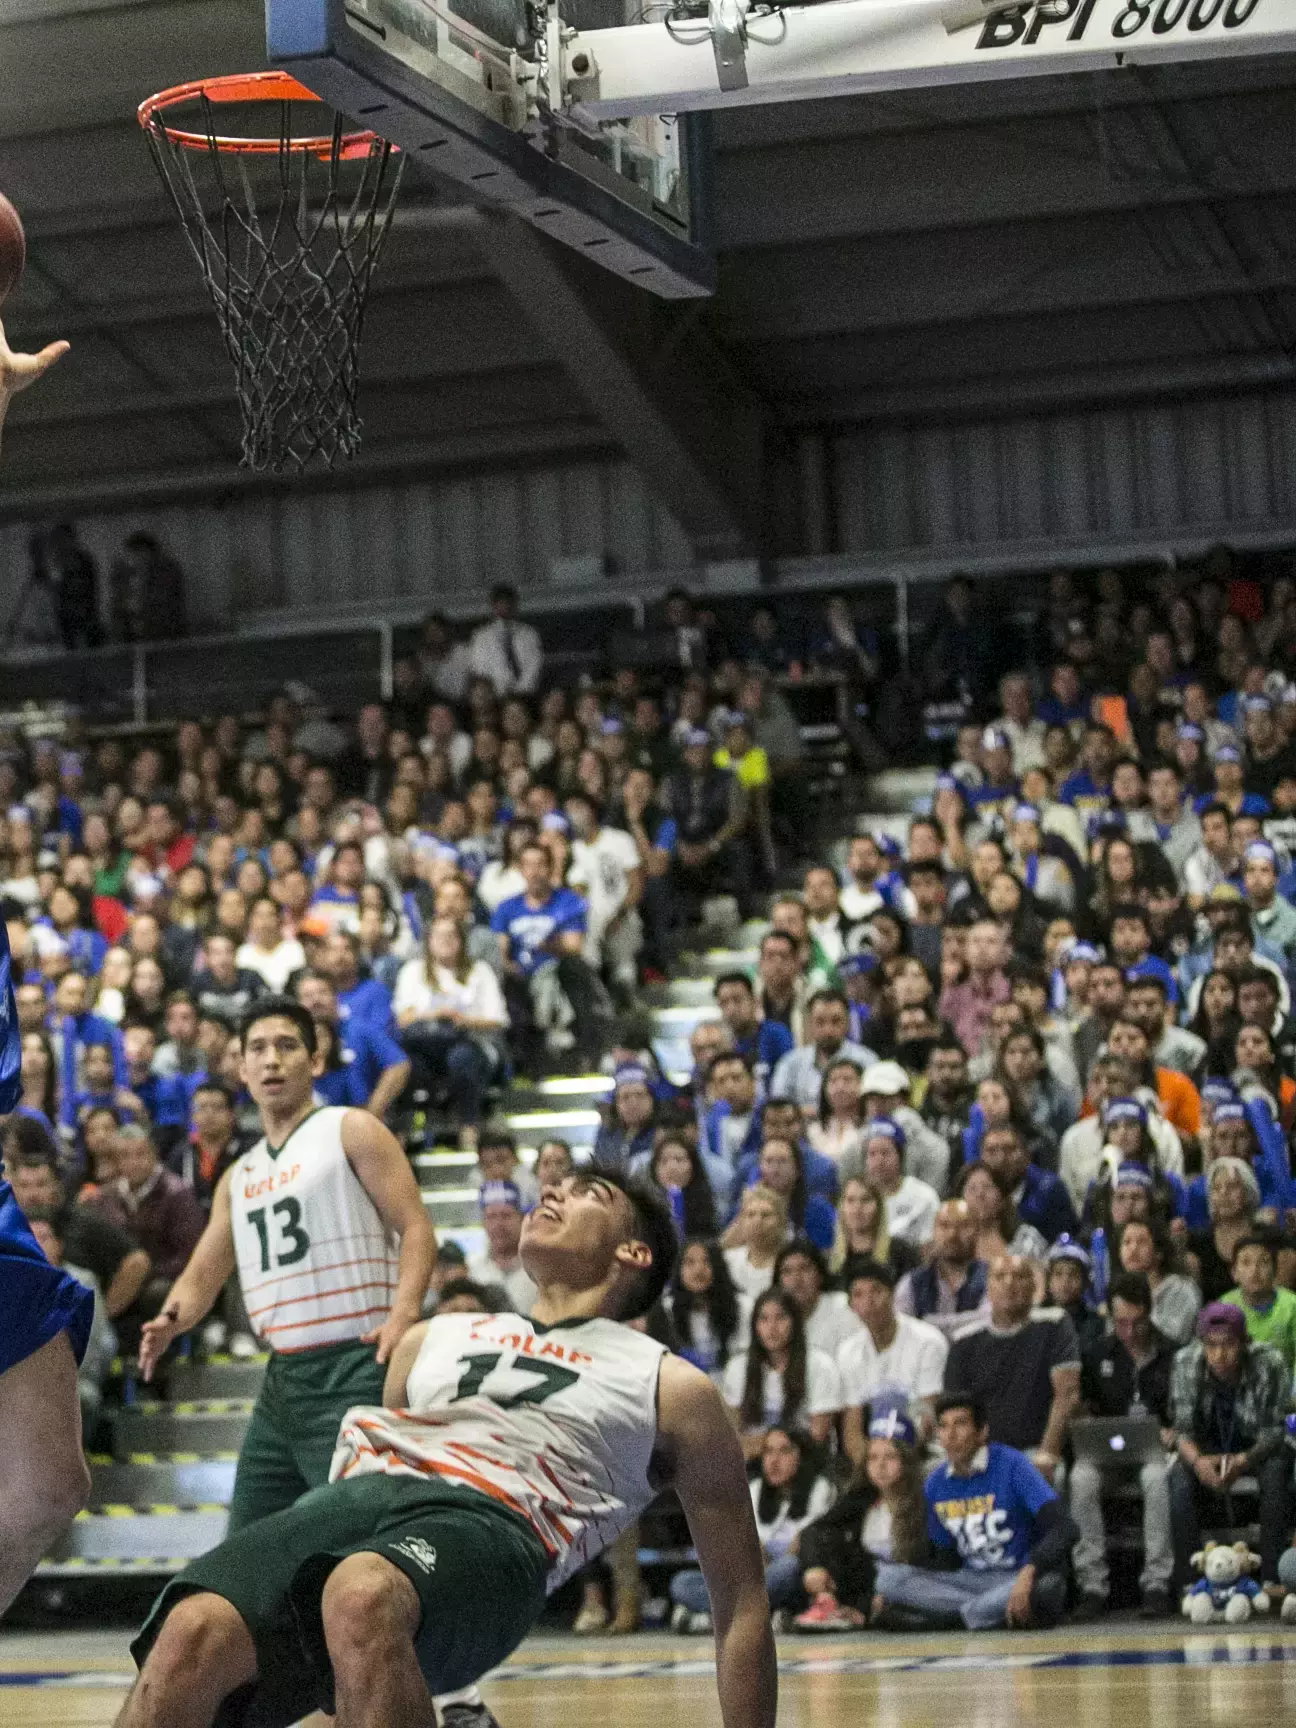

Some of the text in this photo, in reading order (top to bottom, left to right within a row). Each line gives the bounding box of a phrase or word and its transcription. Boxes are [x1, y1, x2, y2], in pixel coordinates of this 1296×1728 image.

[975, 0, 1256, 50] BPI 8000
[247, 1196, 311, 1272] 13
[449, 1352, 581, 1409] 17
